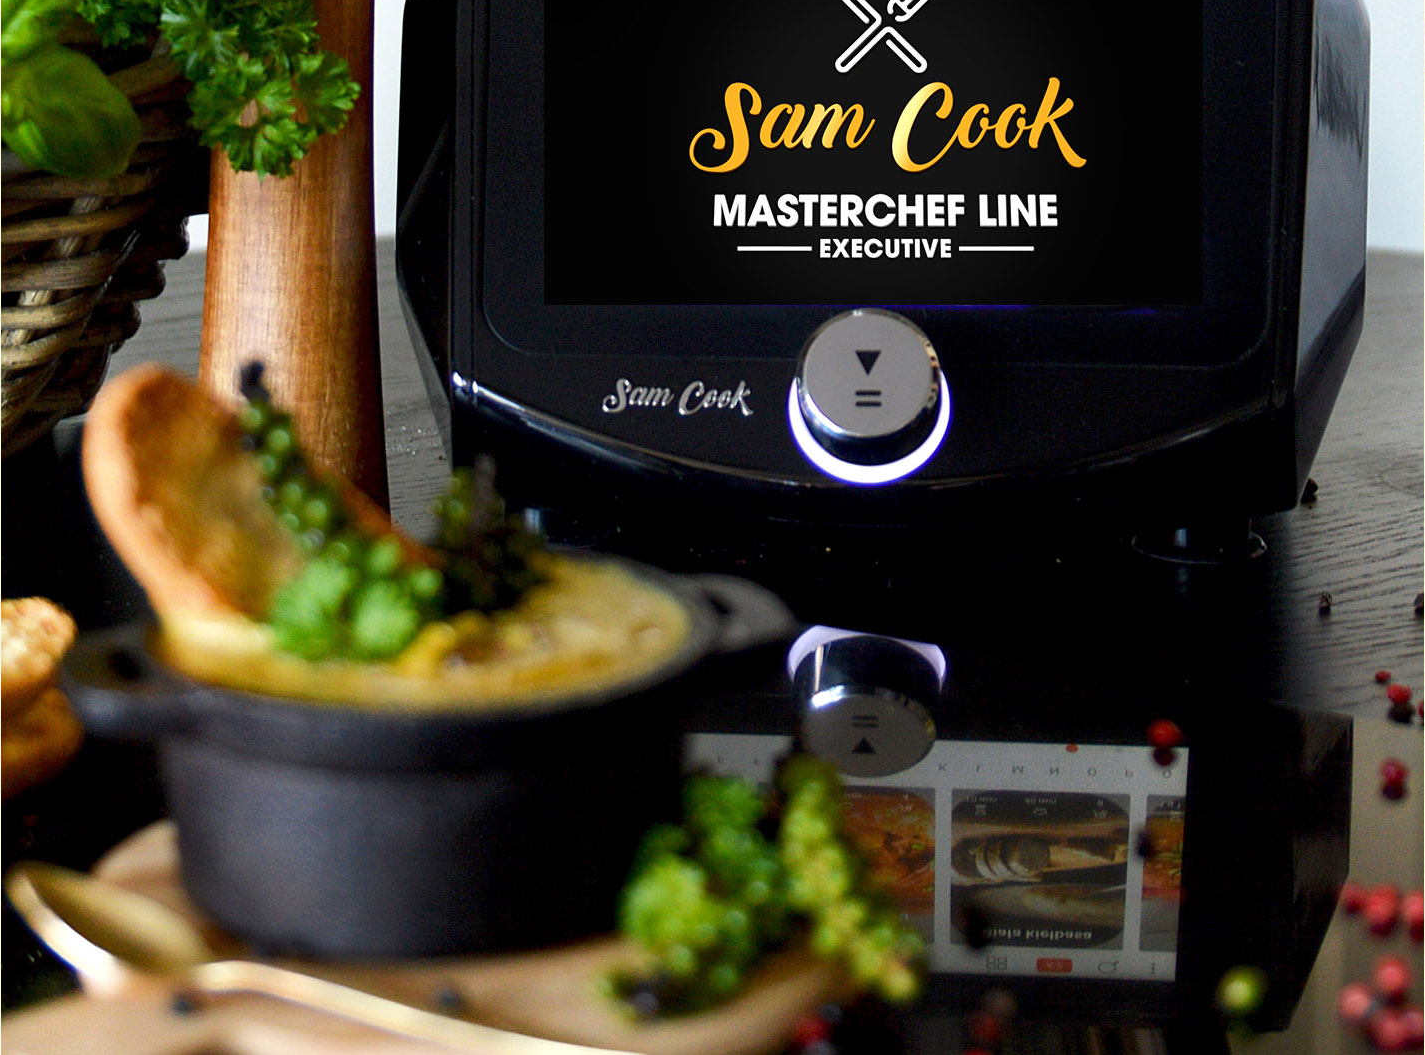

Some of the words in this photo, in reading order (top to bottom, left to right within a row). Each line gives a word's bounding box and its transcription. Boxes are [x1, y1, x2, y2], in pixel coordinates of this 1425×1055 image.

[689, 81, 876, 173] Sam
[891, 76, 1087, 172] Cook
[712, 193, 965, 228] MASTERCHEF
[978, 193, 1058, 228] LINE
[819, 237, 952, 259] EXECUTIVE
[602, 377, 675, 413] Sam
[678, 379, 754, 417] Cook
